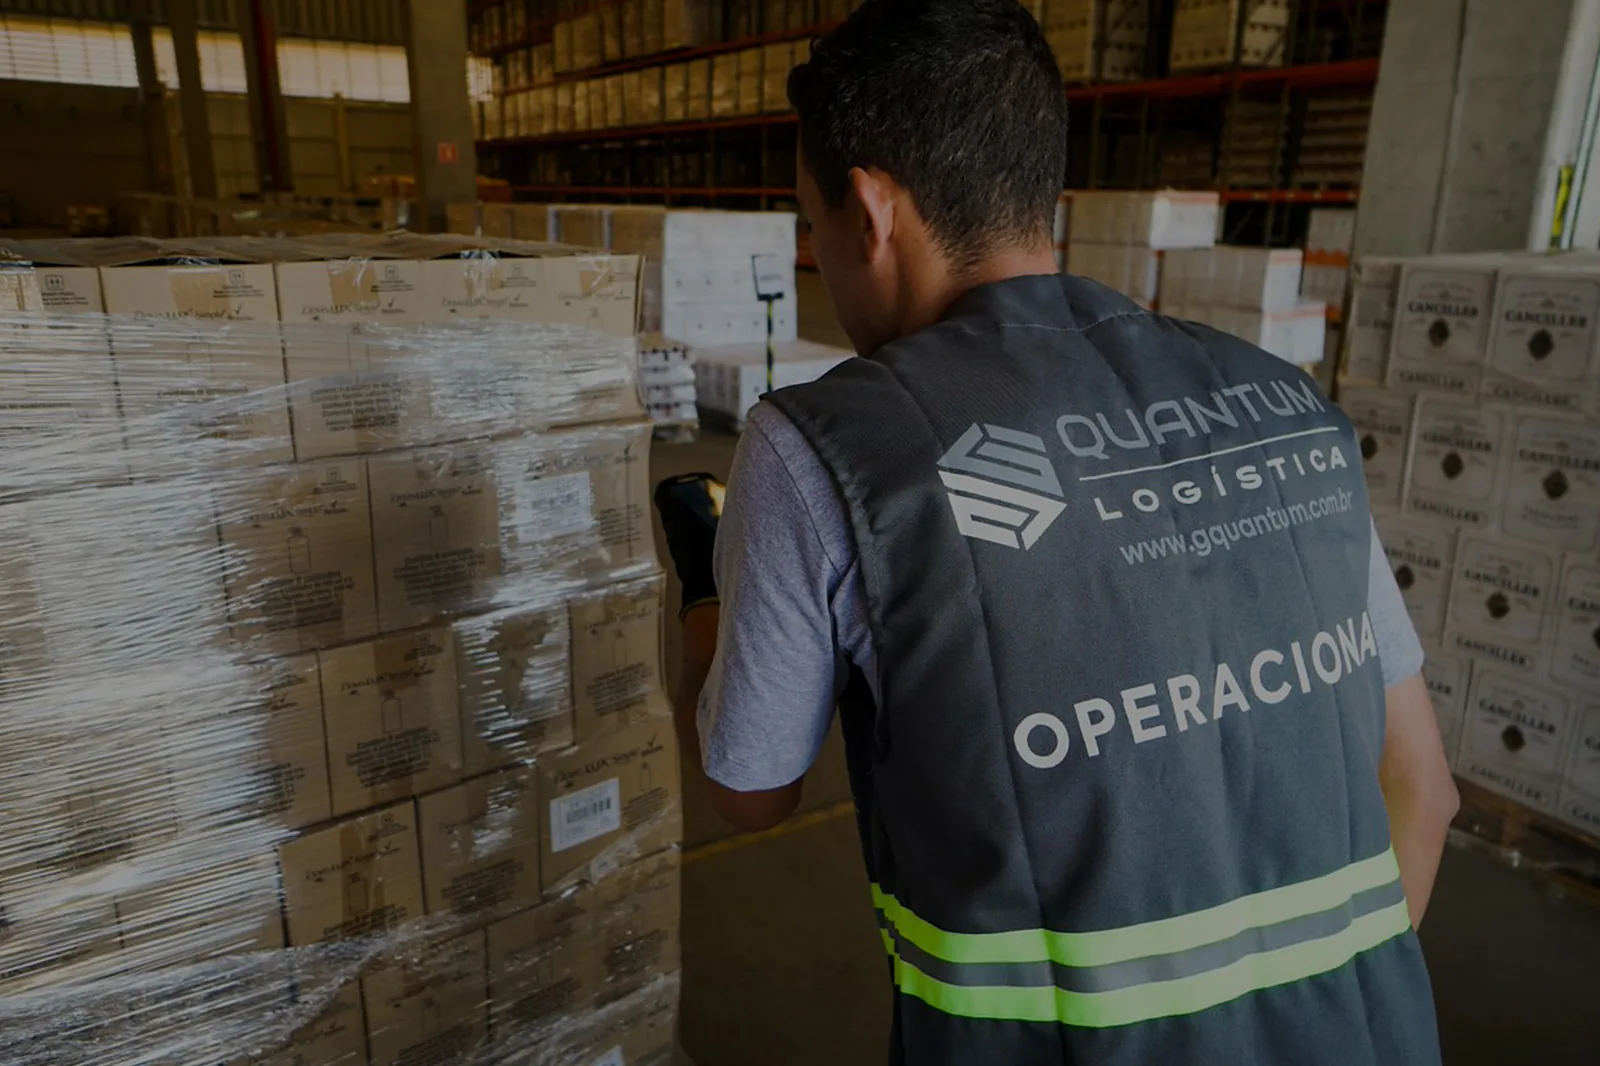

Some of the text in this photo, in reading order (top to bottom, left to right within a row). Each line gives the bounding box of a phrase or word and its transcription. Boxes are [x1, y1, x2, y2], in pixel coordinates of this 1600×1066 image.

[1408, 301, 1479, 317] CANCILLER
[1505, 310, 1588, 328] CANCILLER
[1056, 379, 1326, 460] QUANTUM
[1094, 446, 1348, 521] LOGÍSTICA
[1119, 487, 1353, 565] www.gquantum.com.br
[1479, 699, 1556, 734] CANCILLER
